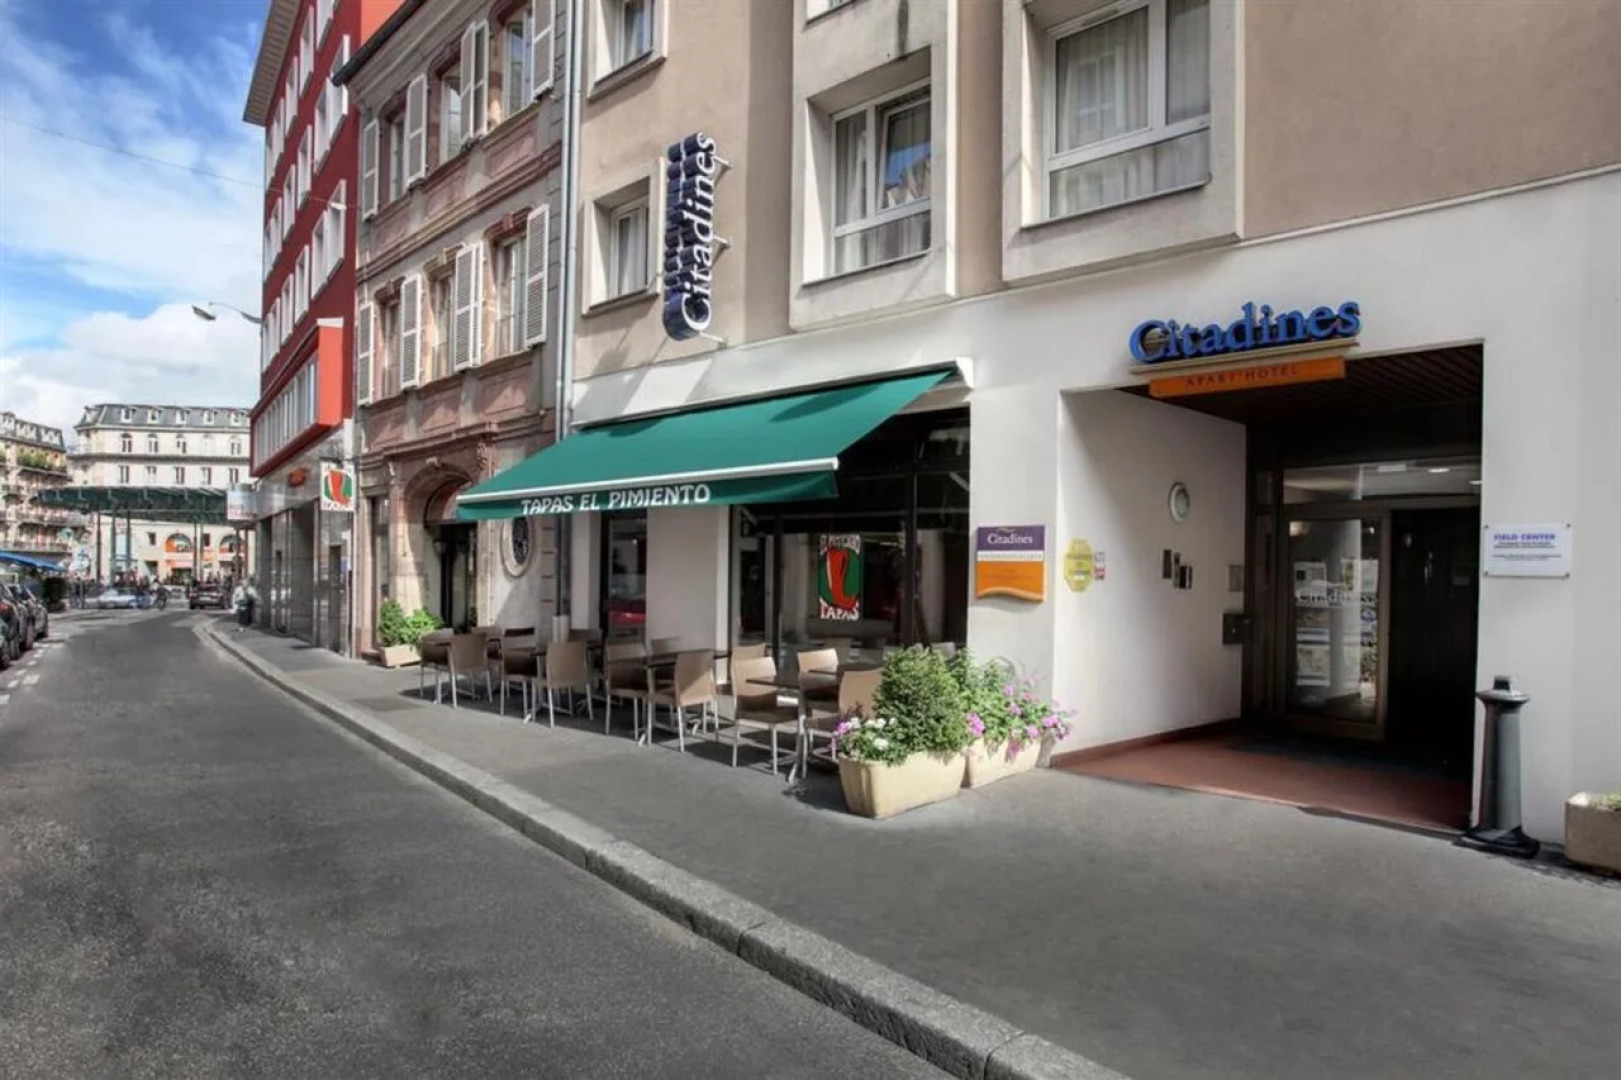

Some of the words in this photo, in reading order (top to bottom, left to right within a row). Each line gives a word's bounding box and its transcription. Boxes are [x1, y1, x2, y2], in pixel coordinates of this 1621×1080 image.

[677, 132, 717, 333] Citadines
[1130, 301, 1361, 364] Citadines
[521, 497, 573, 515] TAPAS
[578, 494, 600, 511] EL
[608, 484, 711, 509] PIMIENTO
[987, 532, 1033, 544] Citadines
[819, 599, 860, 621] TAPAS
